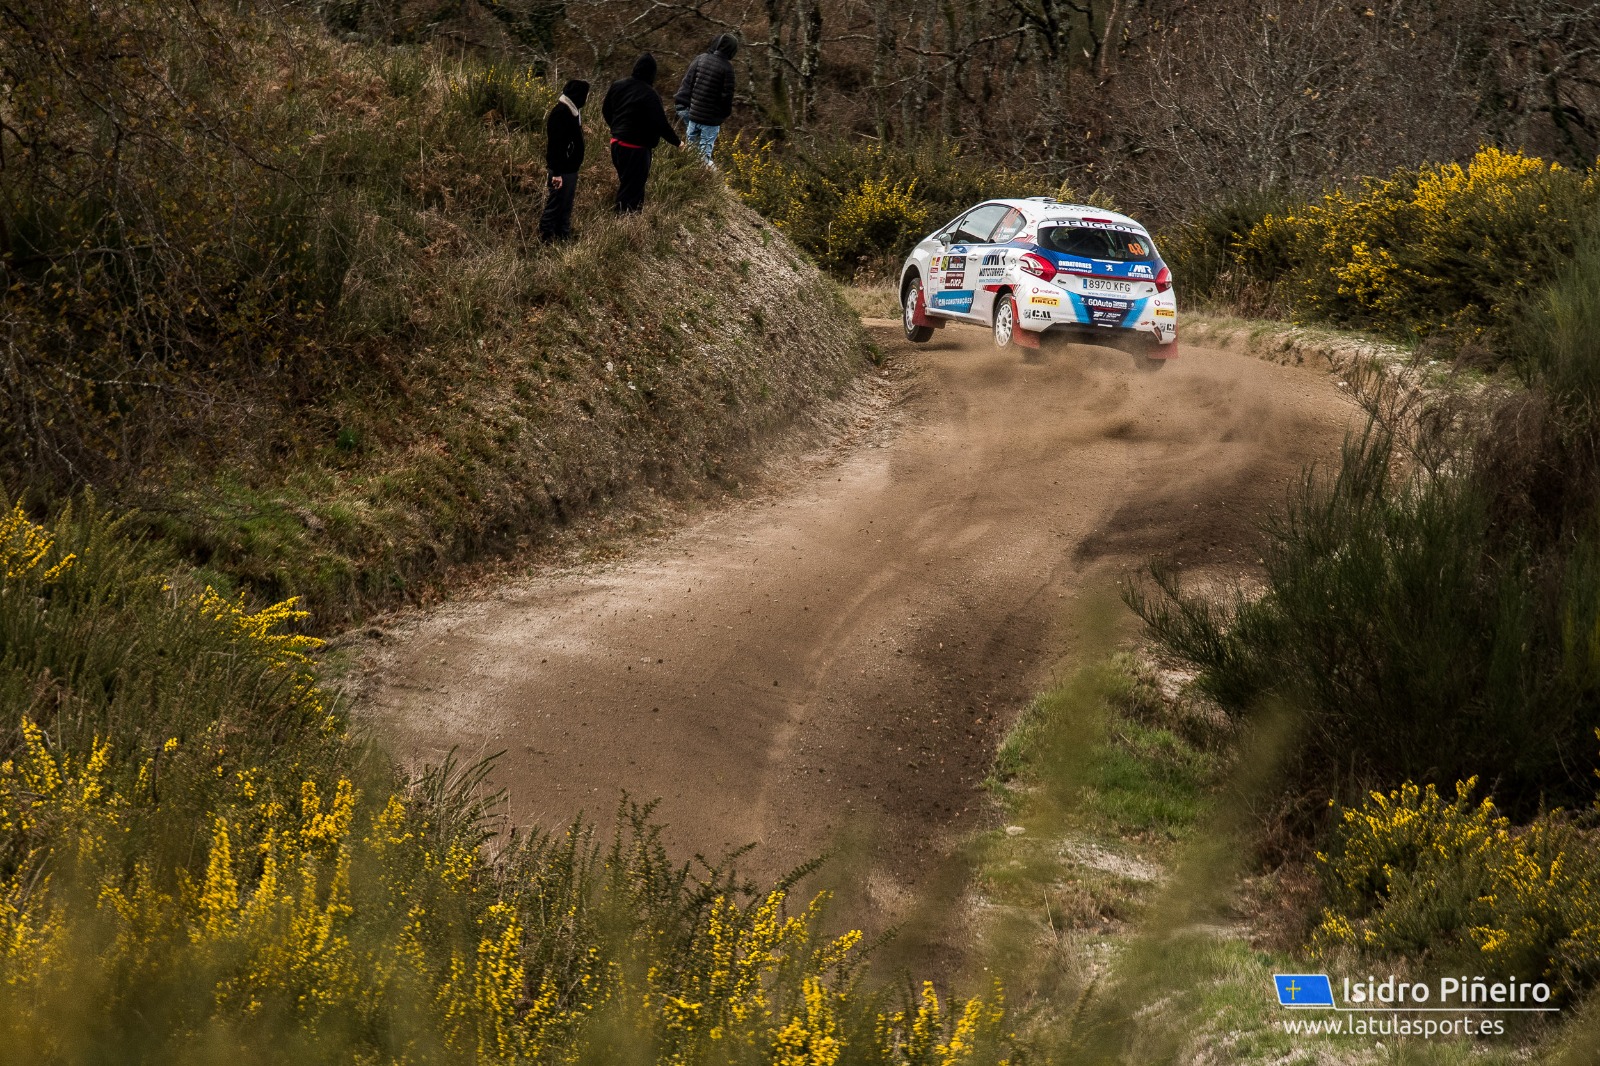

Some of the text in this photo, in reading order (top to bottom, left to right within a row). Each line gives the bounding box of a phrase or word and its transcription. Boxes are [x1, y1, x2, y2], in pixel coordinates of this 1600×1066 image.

[1056, 220, 1134, 232] PEUGEOT
[1127, 243, 1145, 256] 48
[1088, 280, 1131, 292] 8970 KFG
[1031, 297, 1058, 305] PIRELLI
